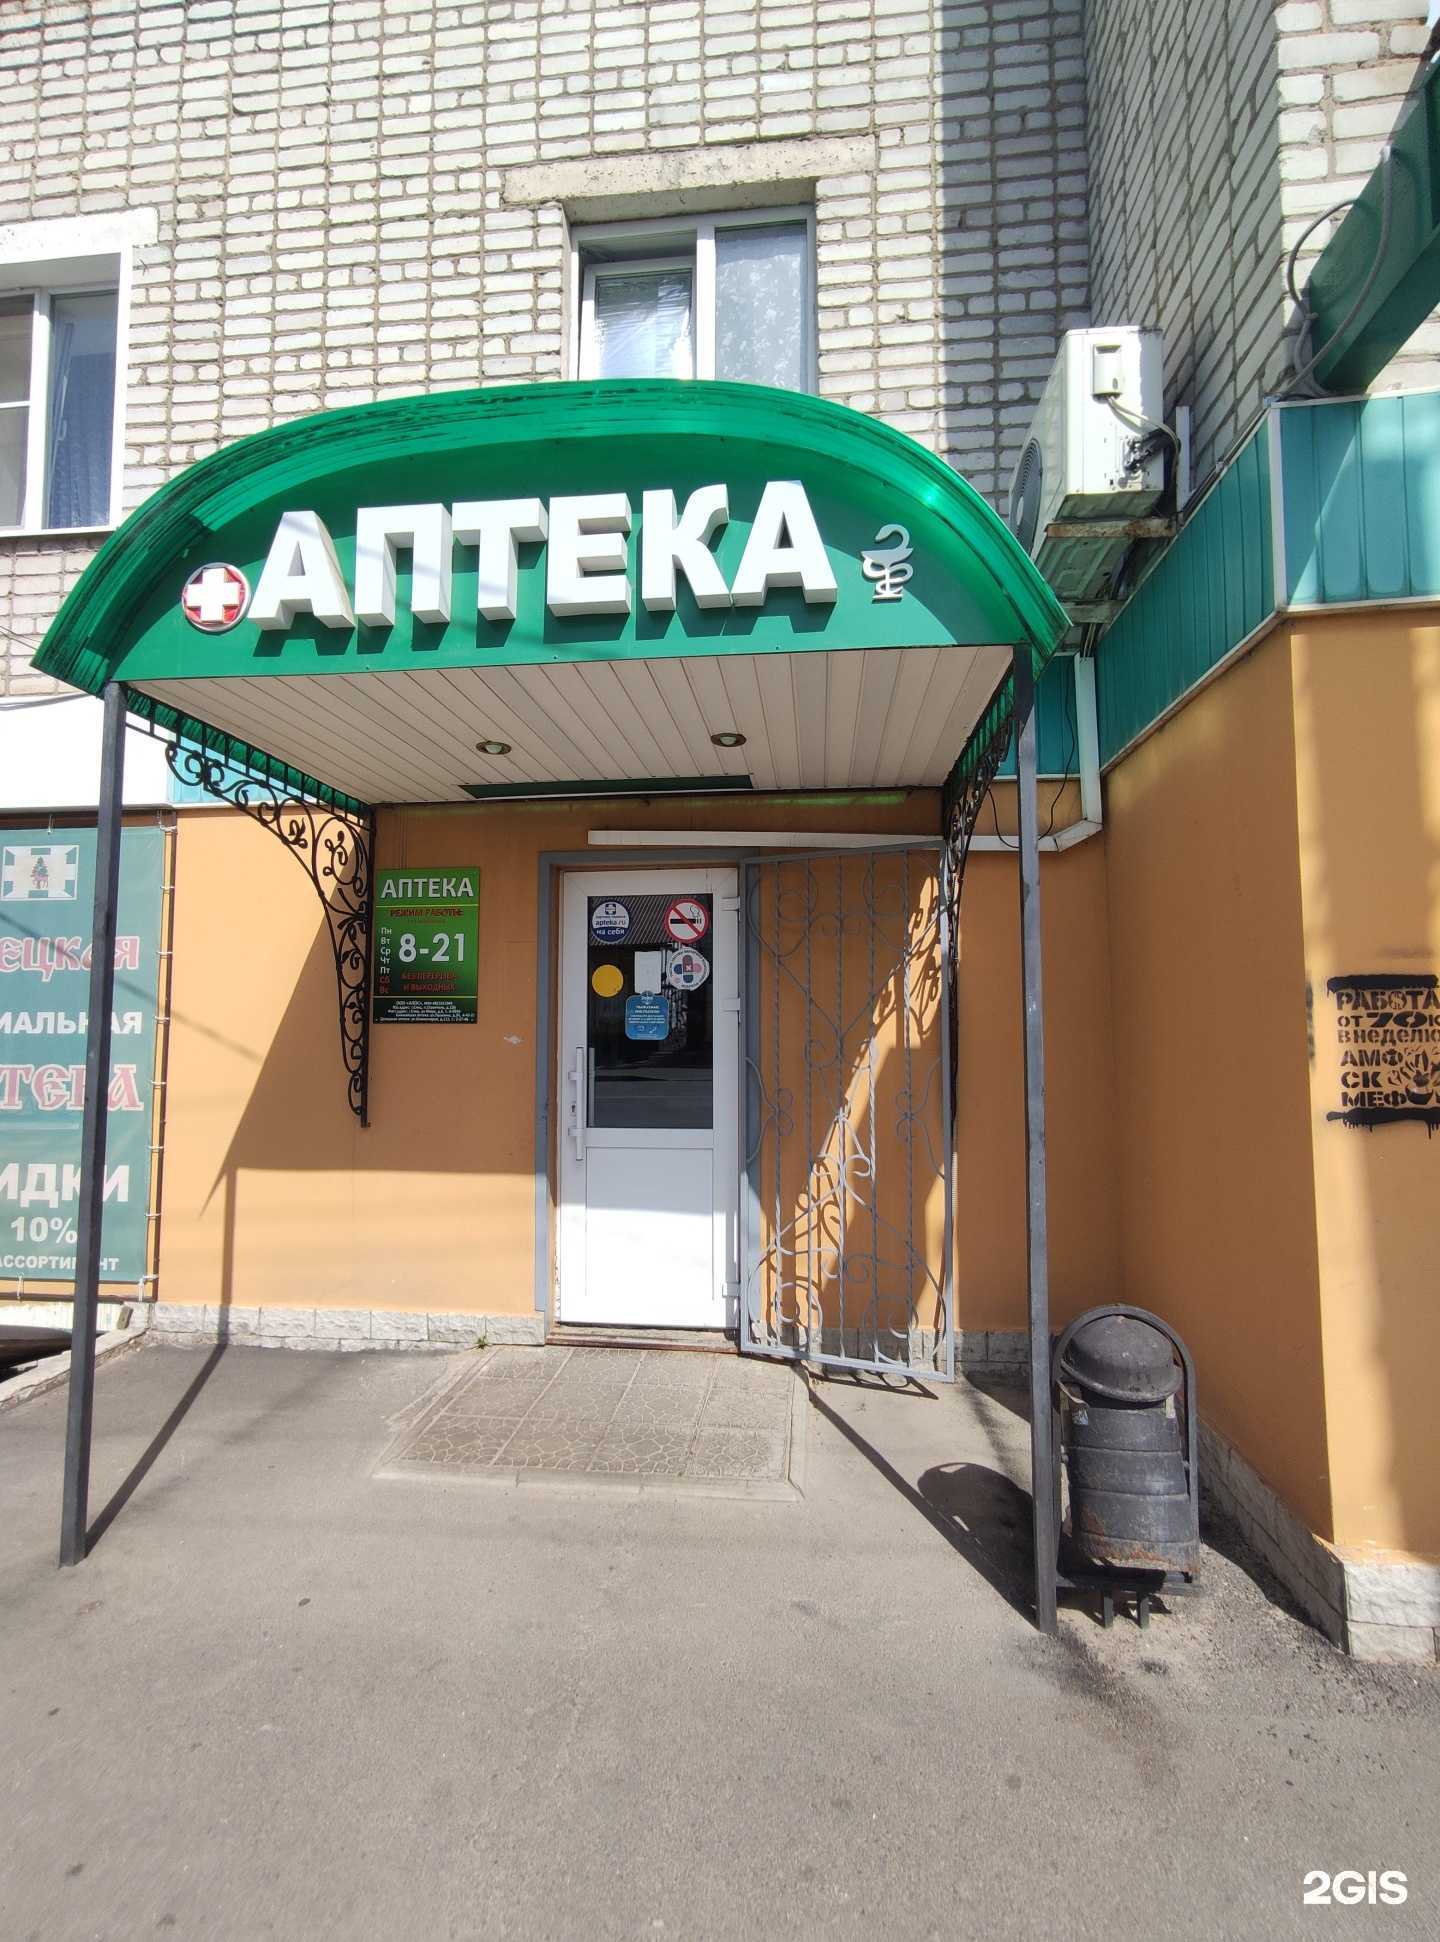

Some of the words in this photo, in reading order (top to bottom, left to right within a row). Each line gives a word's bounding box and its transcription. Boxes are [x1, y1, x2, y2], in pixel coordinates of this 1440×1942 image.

[247, 480, 838, 629] АПТЕКА
[381, 877, 474, 899] АПТЕКА
[380, 937, 391, 945] Вт
[399, 933, 464, 963] 8-21
[380, 947, 391, 955] Ср
[380, 966, 391, 974] Пт
[1337, 990, 1440, 1011] РАБОТА
[1340, 1049, 1404, 1066] АМФ
[1341, 1071, 1383, 1088] СК
[1341, 1090, 1408, 1107] МЕФ
[11, 1216, 78, 1244] 10%
